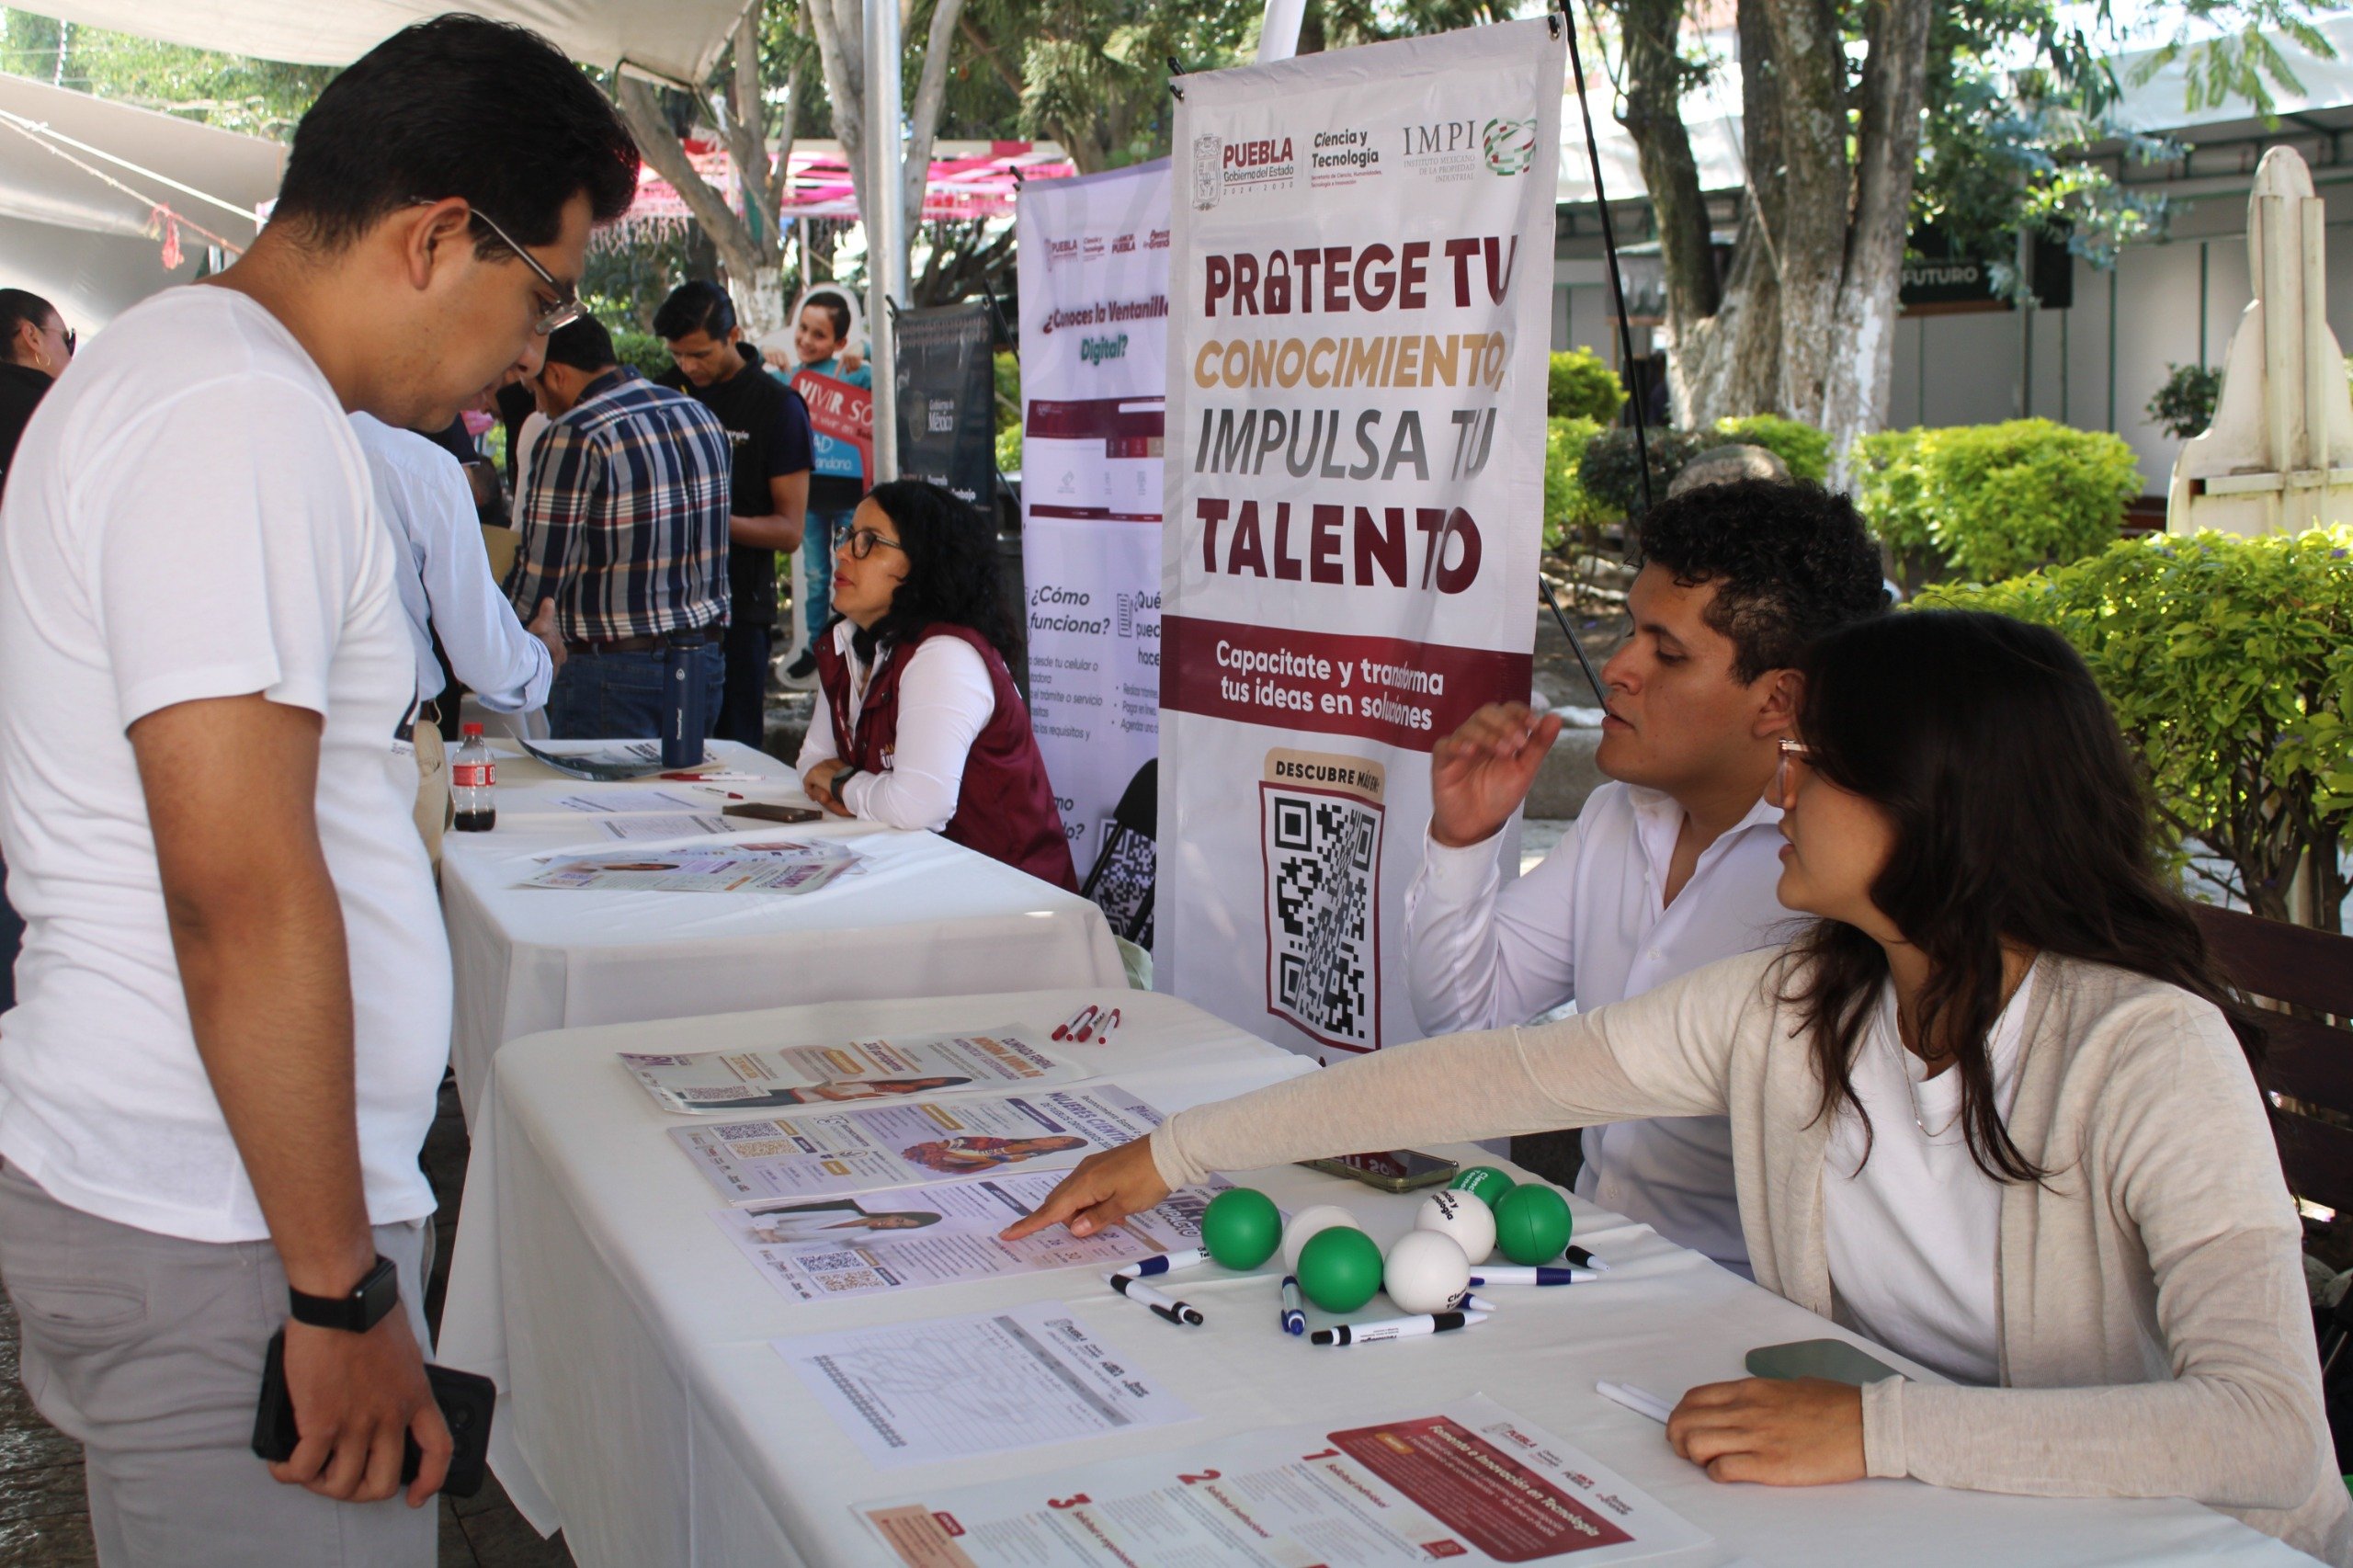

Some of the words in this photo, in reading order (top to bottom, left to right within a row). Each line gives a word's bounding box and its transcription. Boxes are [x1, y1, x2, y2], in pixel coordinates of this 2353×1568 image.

[1314, 129, 1357, 148] Ciencia
[1359, 131, 1368, 147] y
[1403, 120, 1476, 155] IMPI
[1223, 137, 1293, 169] PUEBLA
[1312, 148, 1379, 168] Tecnología
[1404, 157, 1439, 167] INSTITUTO
[1440, 154, 1475, 164] MEXICANO
[1224, 169, 1256, 182] Gobierno
[1256, 167, 1268, 178] del
[1269, 165, 1294, 177] Estado
[1419, 167, 1427, 176] DE
[1429, 166, 1438, 175] LA
[1438, 164, 1475, 173] PROPIEDAD
[1445, 234, 1519, 308] TU
[1901, 267, 1979, 287] FUTURO
[1043, 307, 1093, 334] ¿Conoces
[1096, 302, 1106, 324] la
[1081, 334, 1129, 366] Digital?
[1194, 331, 1506, 392] CONOCIMIENTO,
[799, 378, 844, 415] VIVIR
[847, 399, 874, 427] SO
[928, 411, 953, 432] México
[1194, 408, 1430, 481] IMPULSA
[1451, 407, 1498, 481] TU
[1196, 497, 1483, 595] TALENTO
[1030, 585, 1090, 607] ¿Cómo
[1134, 590, 1161, 612] ¿Qué
[1030, 612, 1110, 635] funciona?
[1138, 647, 1160, 666] hace
[1216, 639, 1332, 681] Capacitate
[1337, 660, 1353, 688] y
[1361, 656, 1444, 696] transforma
[1221, 675, 1250, 704] tus
[1255, 676, 1313, 712] ideas
[1321, 694, 1353, 716] en
[1361, 695, 1433, 732] soluciones
[1276, 761, 1356, 785] DESCUBRE
[1046, 1092, 1096, 1118] MUJERES
[1086, 1118, 1139, 1142] CIENTÍF
[1460, 1169, 1482, 1190] Tecno
[1506, 1429, 1538, 1449] PUEBLA
[1302, 1447, 1343, 1463] 1
[1175, 1468, 1223, 1488] 2
[1428, 1425, 1473, 1451] Fomento
[1474, 1454, 1533, 1490] Innovación
[1524, 1488, 1546, 1499] en
[1536, 1496, 1603, 1537] Tecnología
[1047, 1493, 1092, 1509] 3
